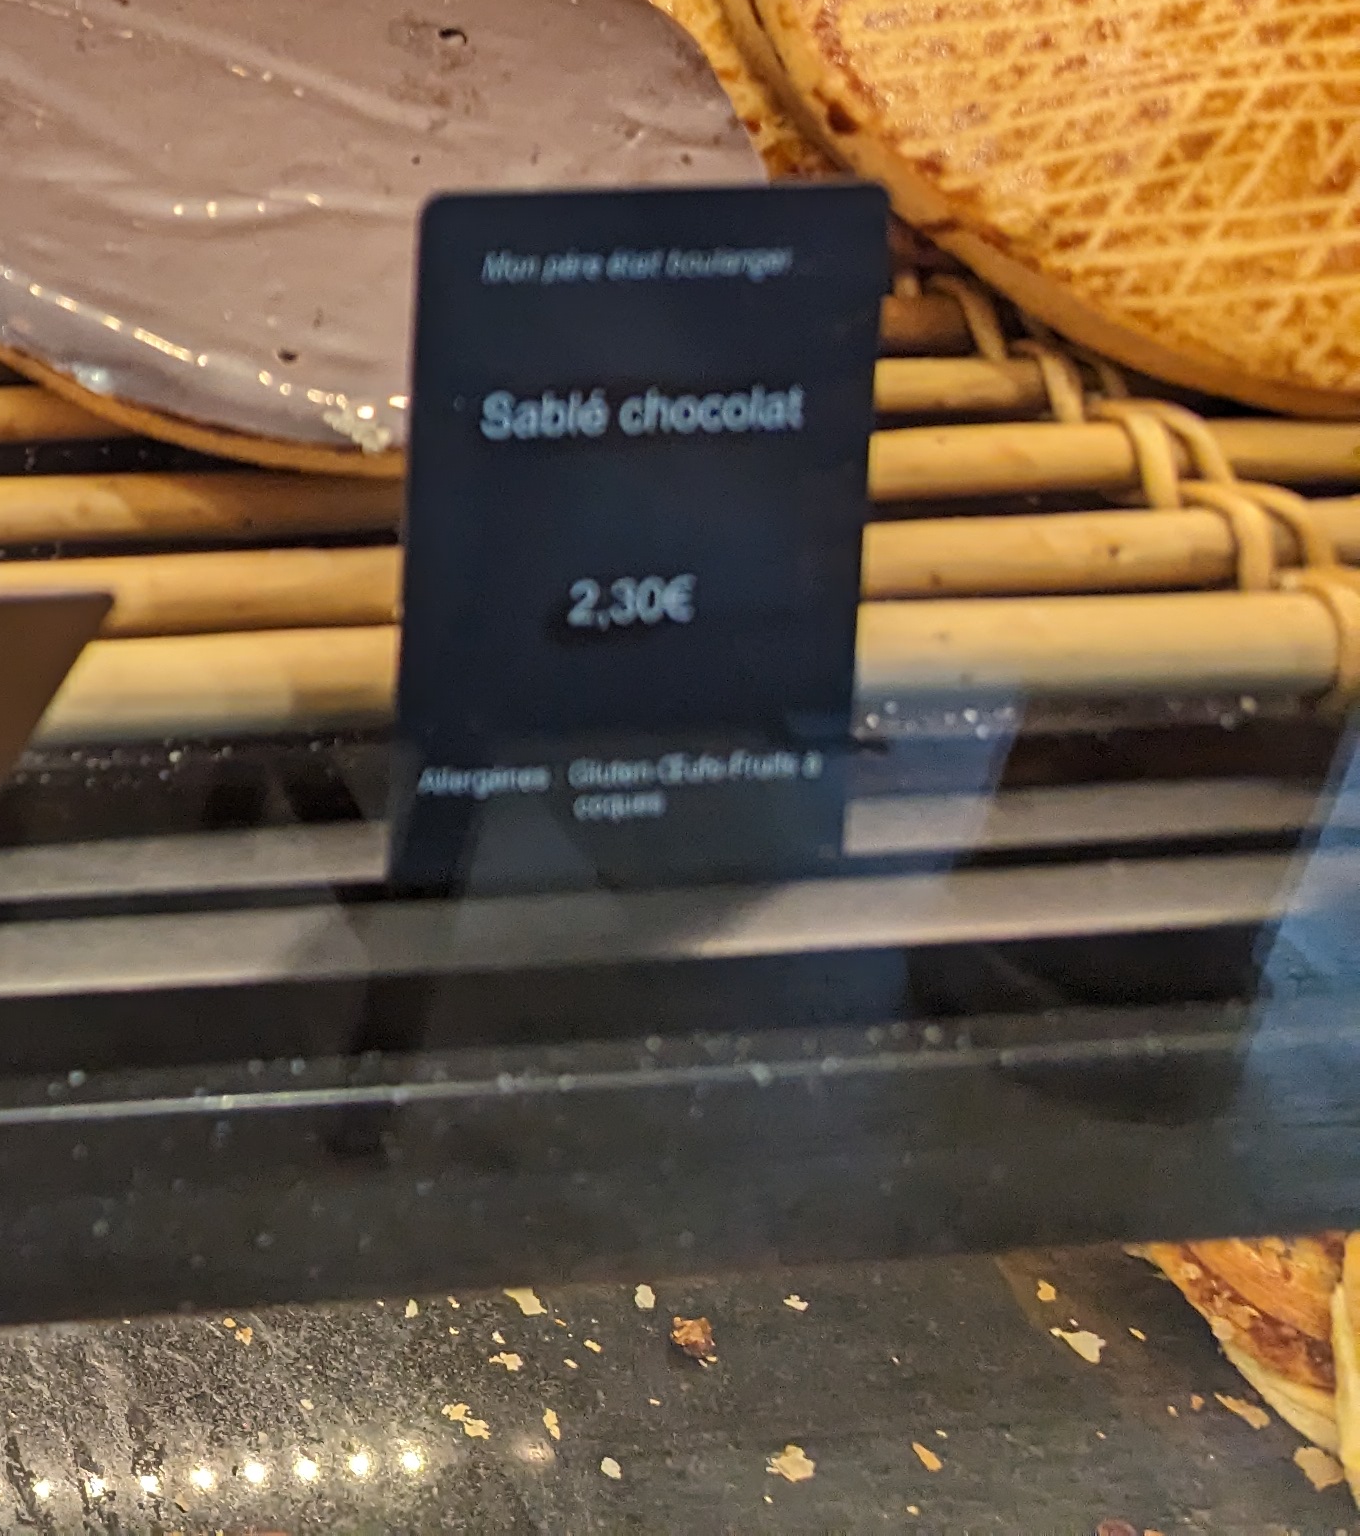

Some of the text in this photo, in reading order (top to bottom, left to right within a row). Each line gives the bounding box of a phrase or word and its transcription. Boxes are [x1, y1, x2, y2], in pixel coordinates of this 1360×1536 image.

[481, 251, 540, 284] Mon
[479, 383, 805, 440] Sablé chocolat
[567, 574, 697, 631] 2,30€
